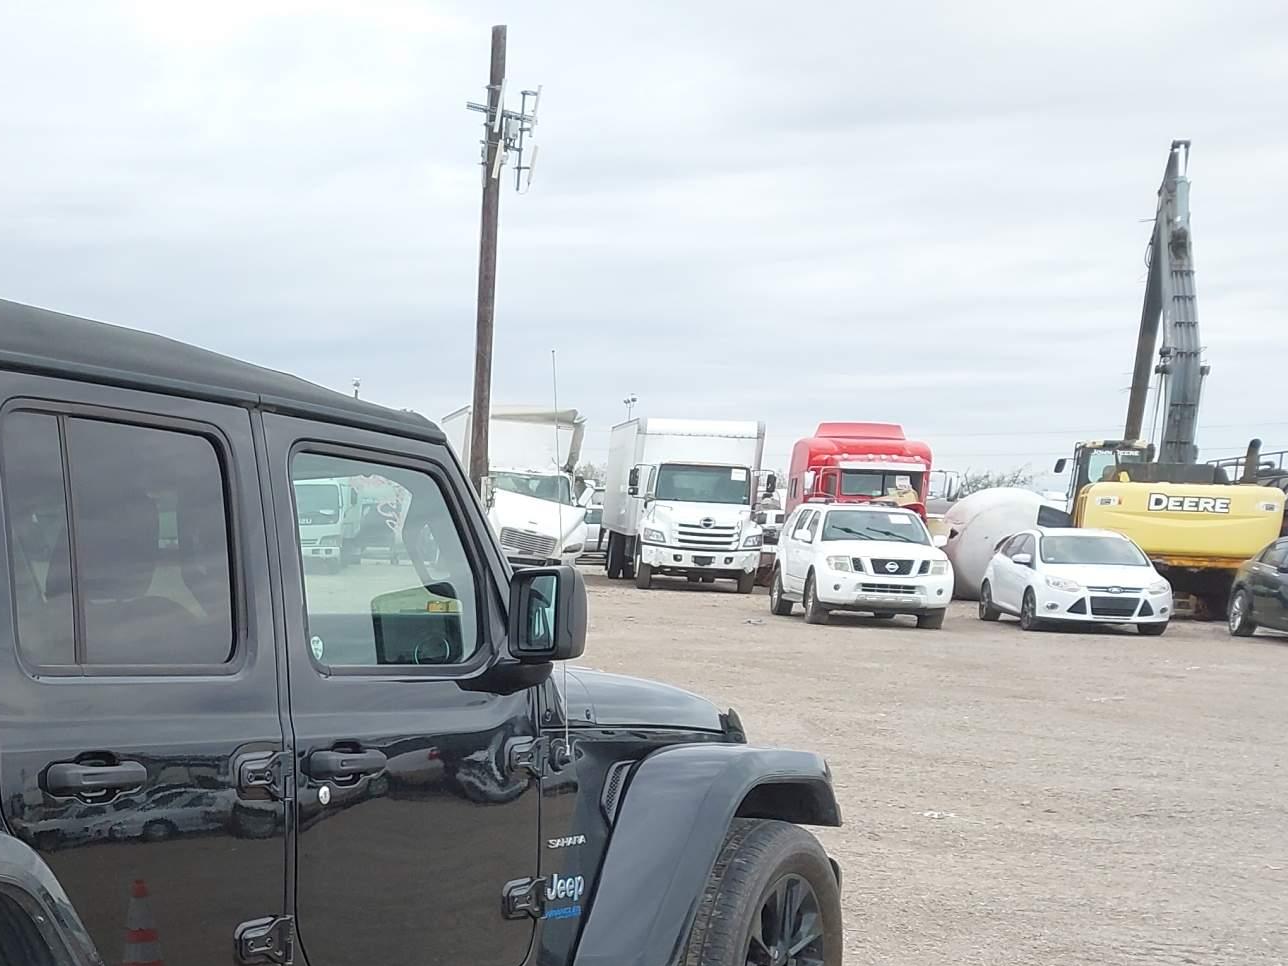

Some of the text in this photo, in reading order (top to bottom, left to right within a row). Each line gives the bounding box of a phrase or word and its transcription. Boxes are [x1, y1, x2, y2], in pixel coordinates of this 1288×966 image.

[1148, 492, 1231, 513] DEERE
[547, 834, 587, 849] SAHARA
[546, 873, 585, 901] Jeep
